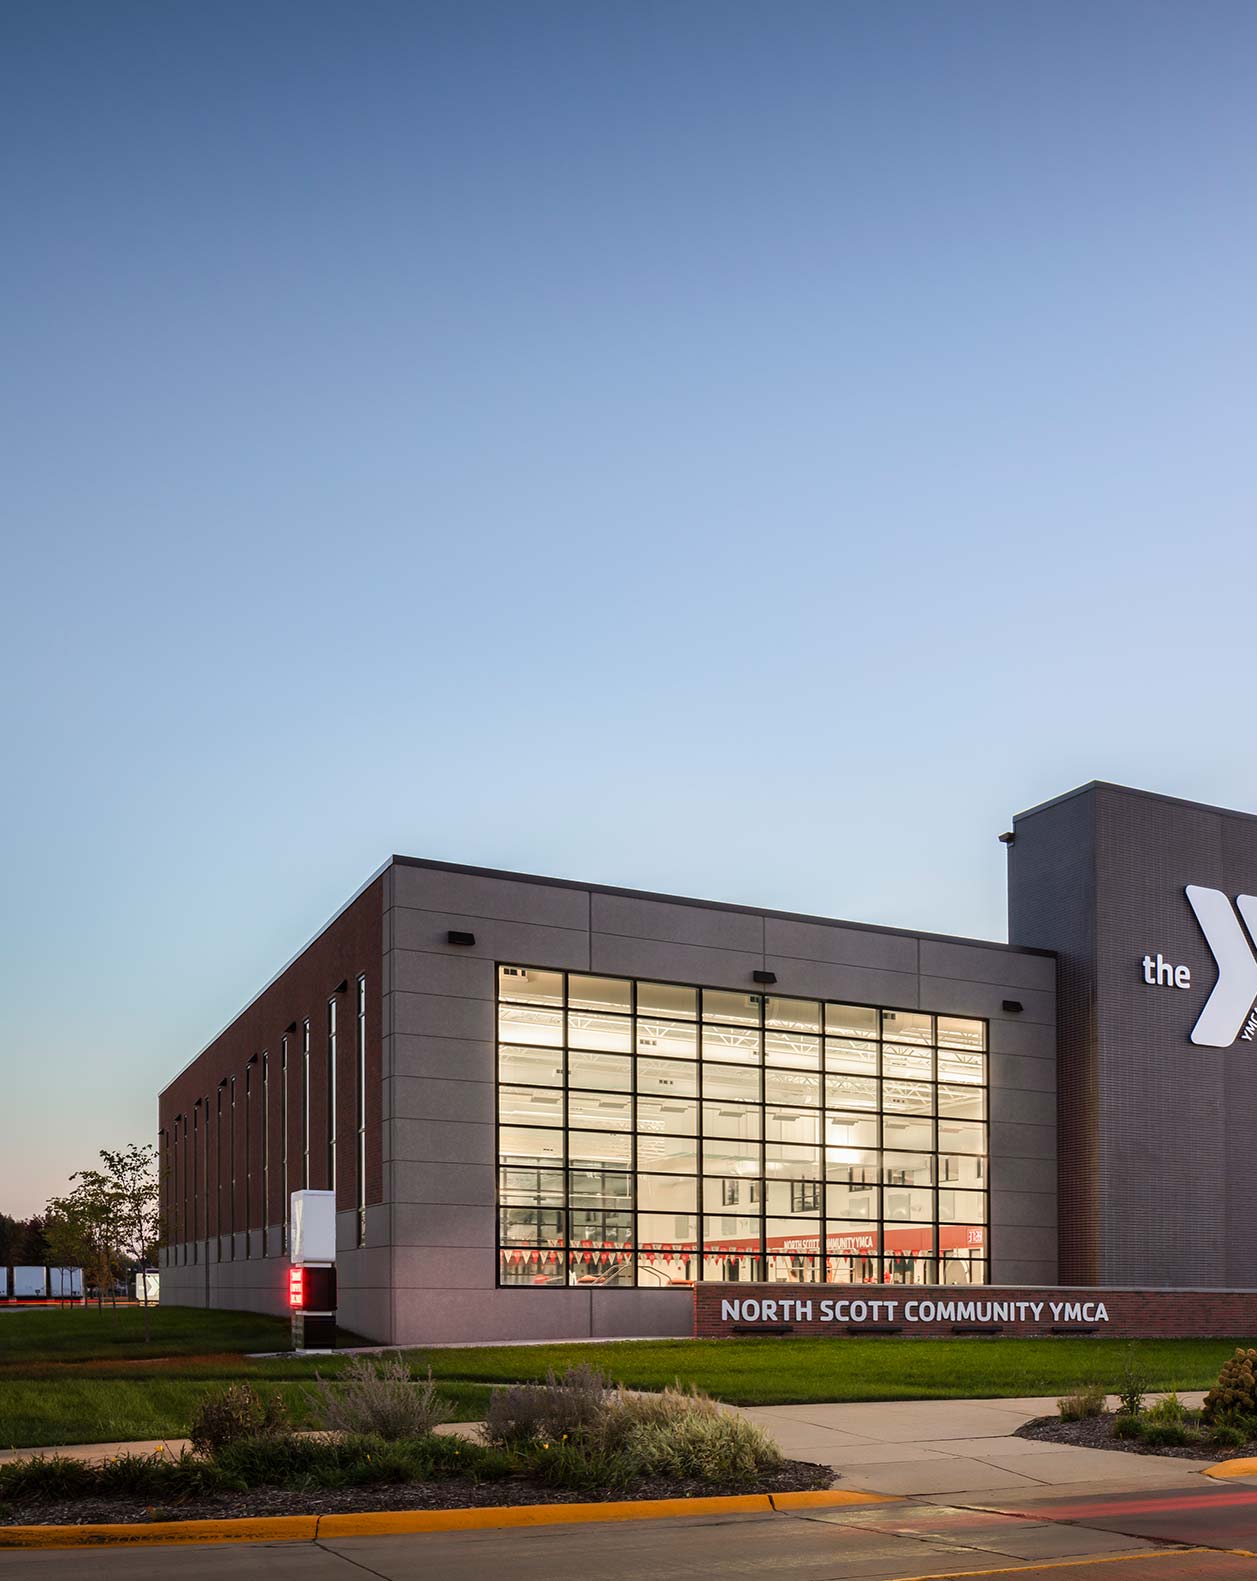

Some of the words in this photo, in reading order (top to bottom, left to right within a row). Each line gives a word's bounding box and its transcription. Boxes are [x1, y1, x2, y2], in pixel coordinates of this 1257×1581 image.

[1142, 954, 1191, 989] the
[784, 1240, 802, 1249] NORTH
[803, 1239, 820, 1249] SCOTT
[855, 1236, 873, 1248] YMCA
[721, 1299, 812, 1322] NORTH
[820, 1300, 898, 1322] SCOTT
[904, 1300, 1044, 1322] COMMUNITY
[1050, 1302, 1109, 1322] YMCA
